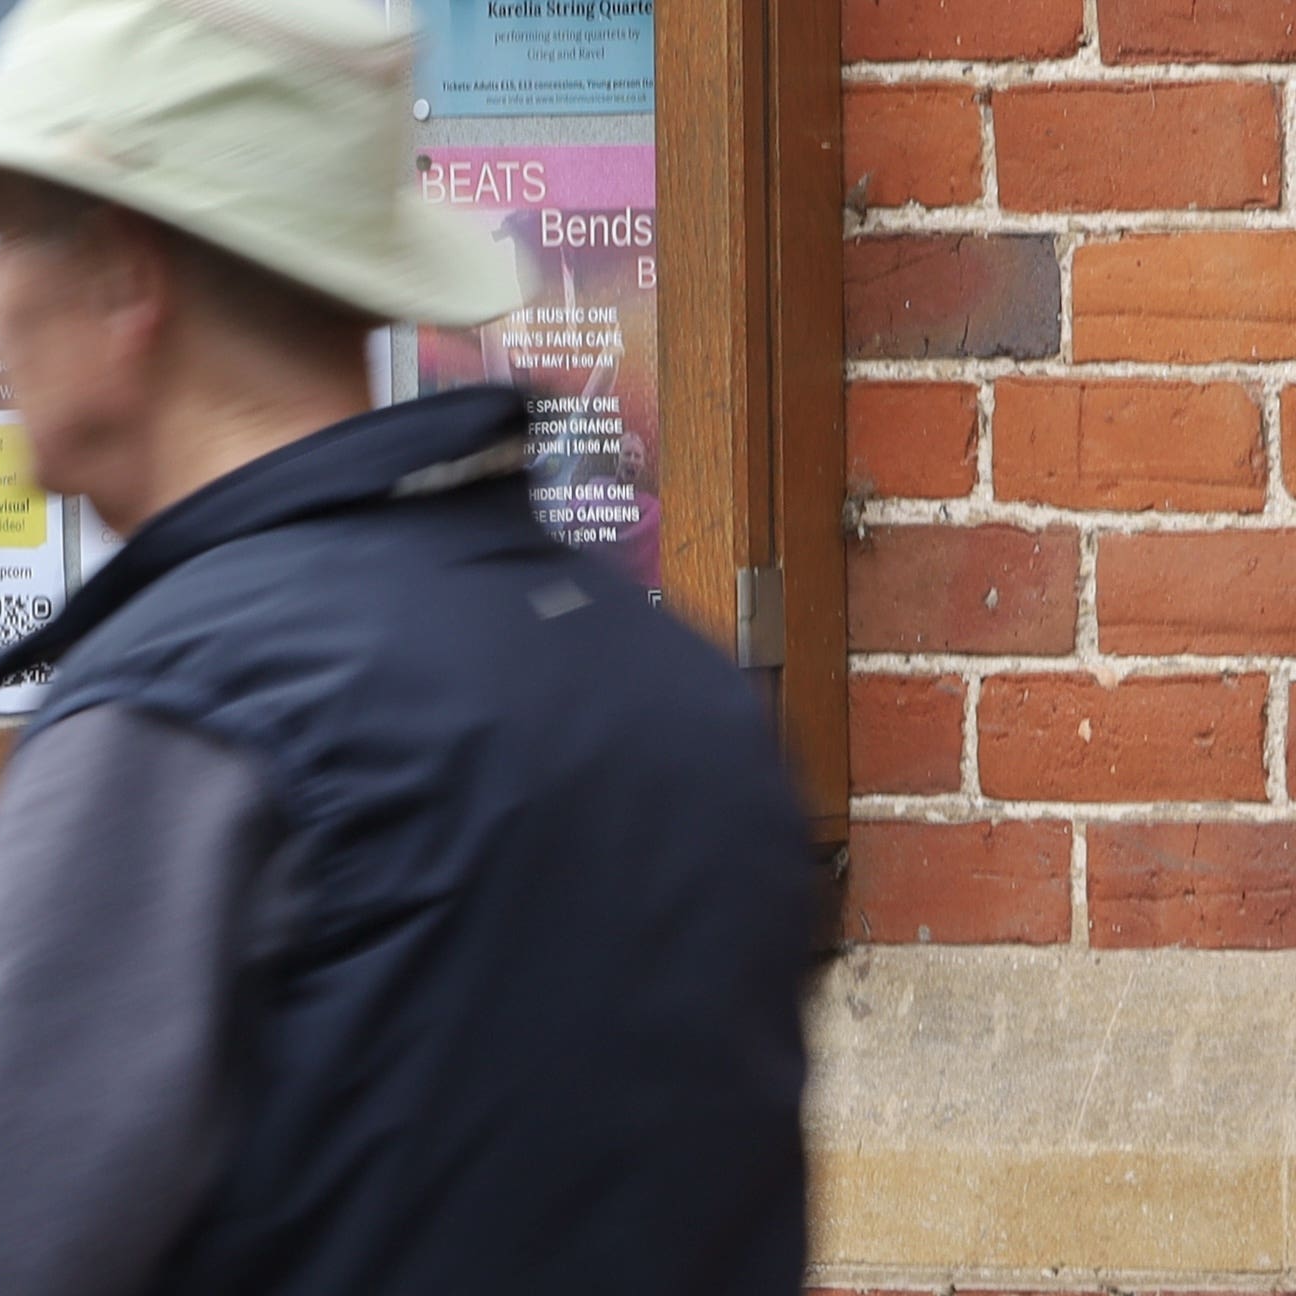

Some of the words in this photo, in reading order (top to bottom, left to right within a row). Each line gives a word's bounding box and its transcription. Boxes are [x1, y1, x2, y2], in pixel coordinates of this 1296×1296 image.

[494, 28, 551, 45] performing
[553, 27, 582, 44] string
[584, 28, 626, 45] quartets
[628, 27, 640, 43] by
[421, 161, 546, 202] BEATS
[541, 206, 653, 248] Bends
[536, 396, 590, 413] SPARKLY
[592, 396, 620, 413] ONE
[569, 418, 623, 435] GRANGE
[529, 485, 573, 500] HIDDEN
[575, 484, 604, 500] GEM
[607, 484, 634, 500] ONE
